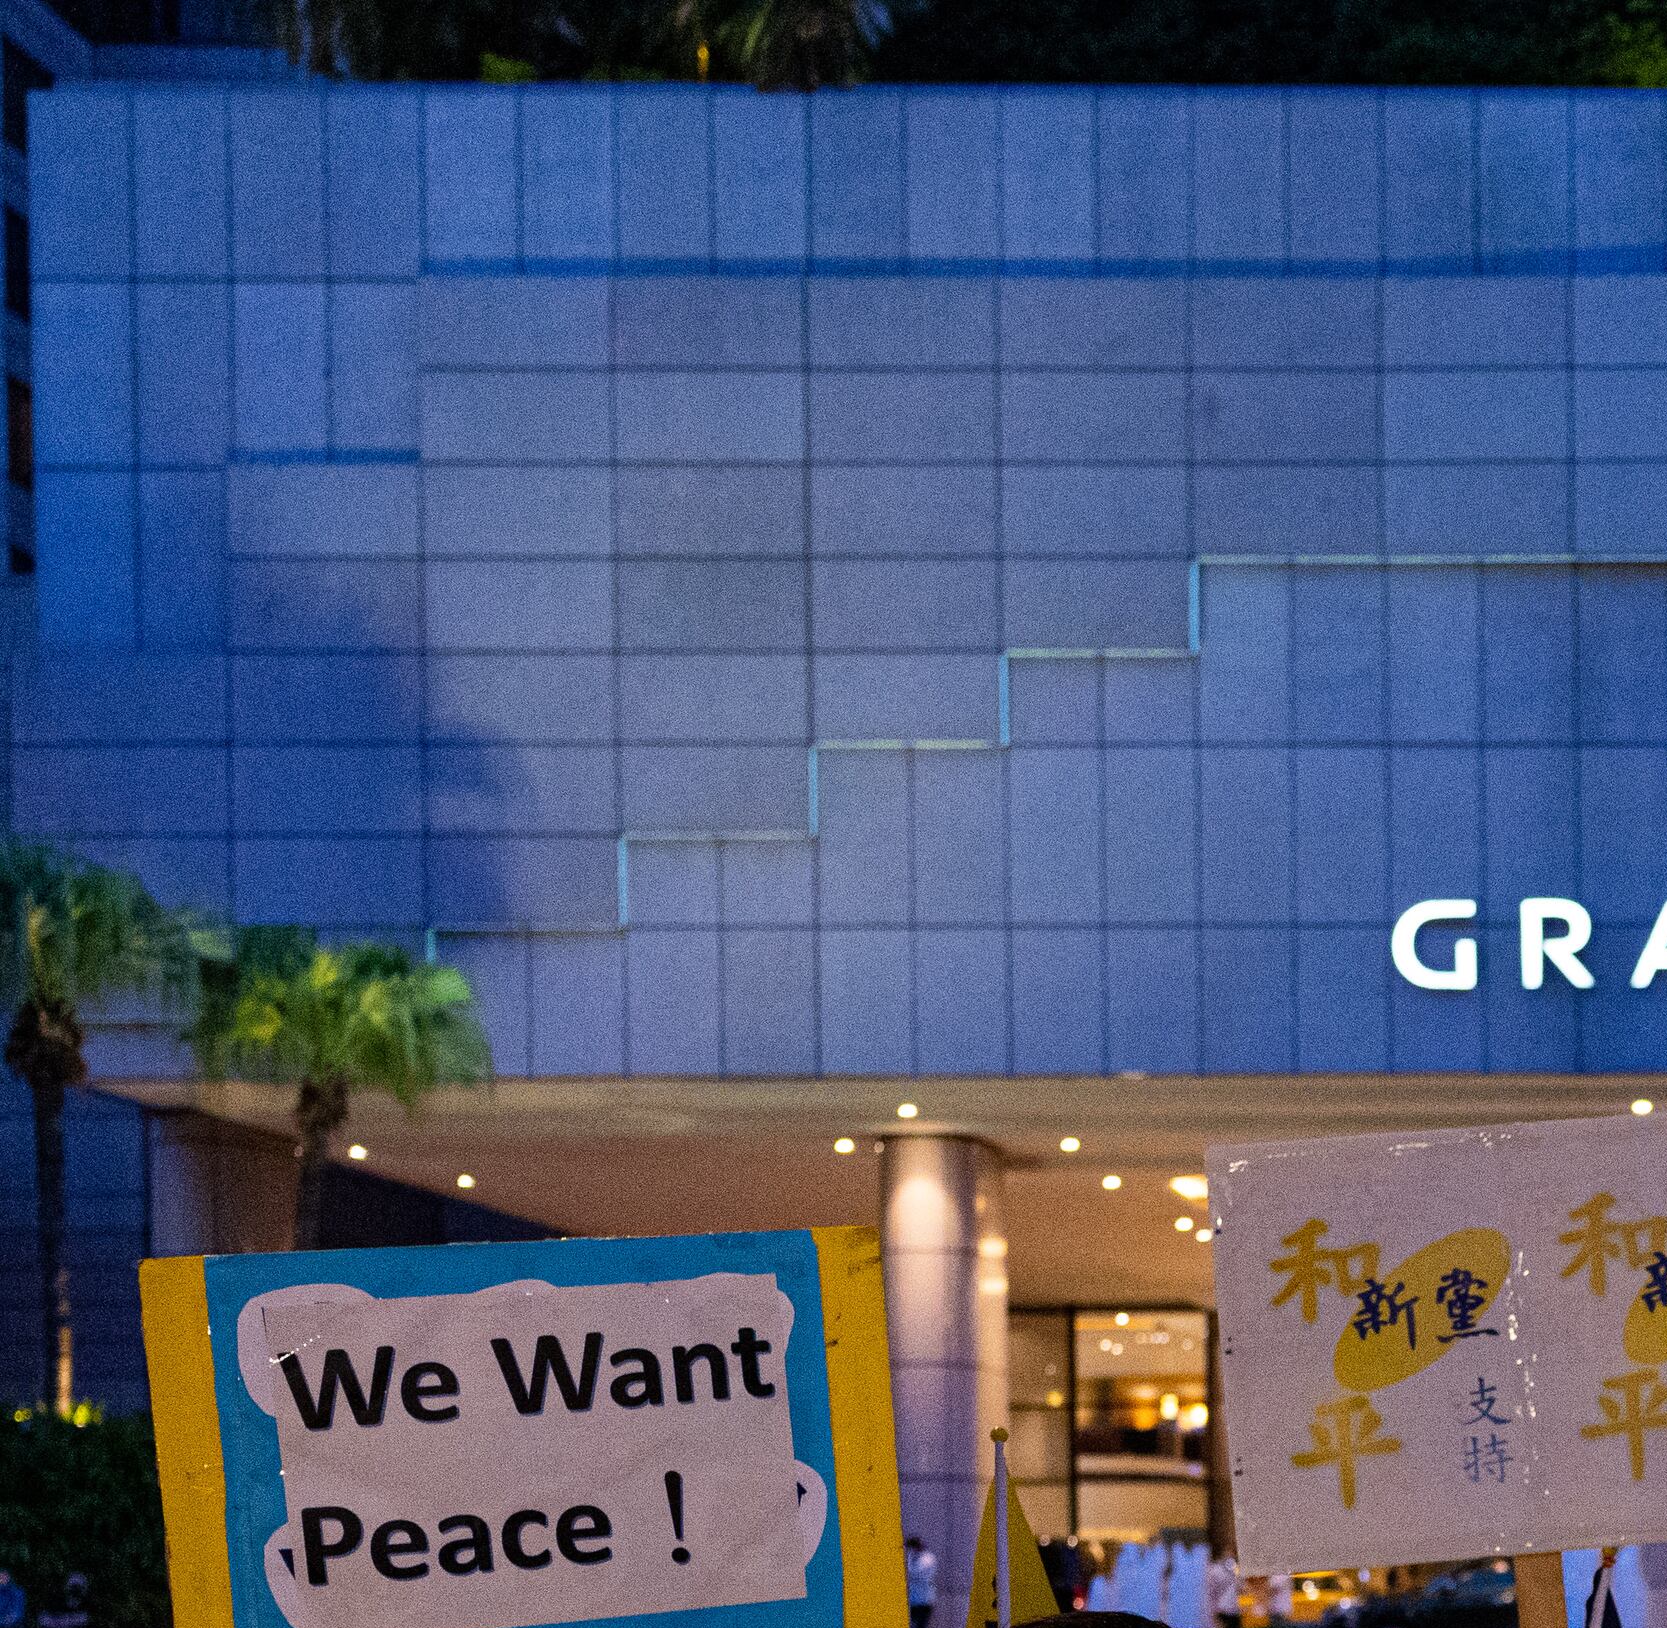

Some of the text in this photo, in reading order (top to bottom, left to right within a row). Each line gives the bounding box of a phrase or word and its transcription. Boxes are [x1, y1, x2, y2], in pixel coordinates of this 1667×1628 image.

[1353, 1267, 1500, 1350] 新黨
[277, 1326, 777, 1432] We Want
[1269, 1218, 1402, 1511] 和平
[1461, 1376, 1514, 1485] 支持
[299, 1503, 614, 1588] Peace
